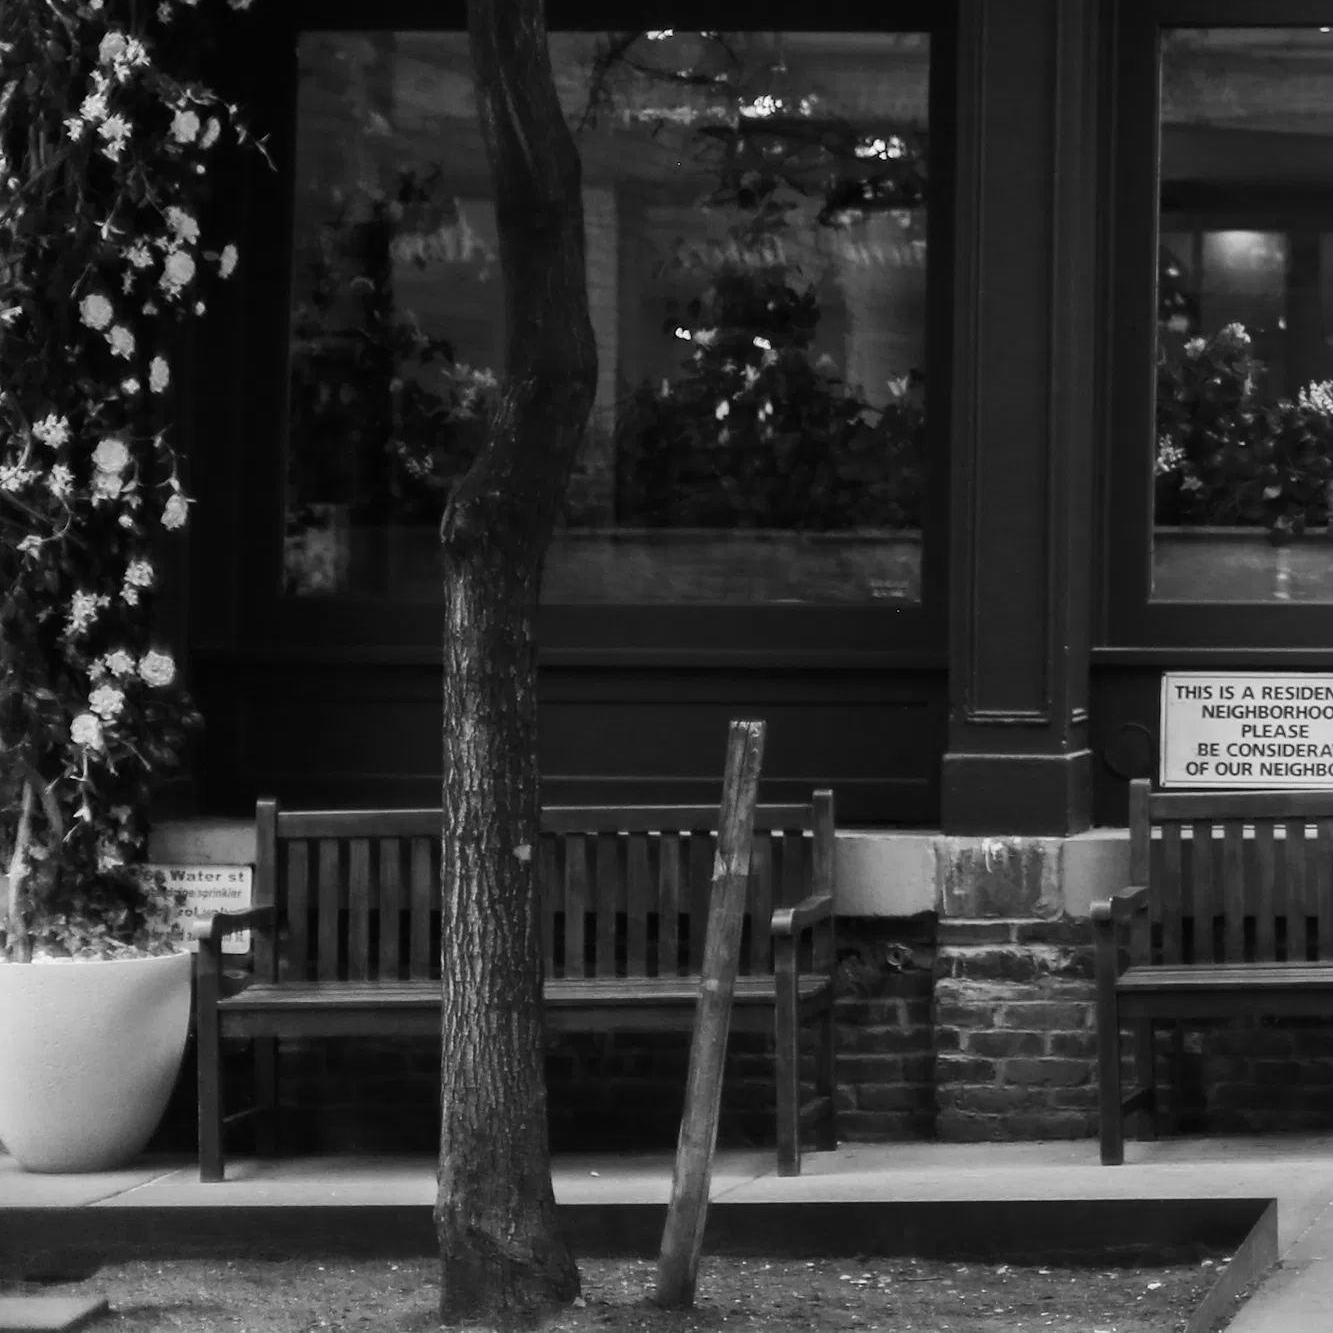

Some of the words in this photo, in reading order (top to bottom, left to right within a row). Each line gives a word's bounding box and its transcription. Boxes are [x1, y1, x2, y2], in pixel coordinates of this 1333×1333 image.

[1175, 686, 1212, 699] THIS
[1219, 686, 1234, 699] IS
[1241, 686, 1254, 699] A
[1241, 724, 1309, 738] PLEASE
[1197, 743, 1219, 757] BE
[1185, 762, 1209, 776] OF
[1215, 762, 1253, 776] OUR
[170, 870, 221, 882] Water
[228, 872, 244, 883] st
